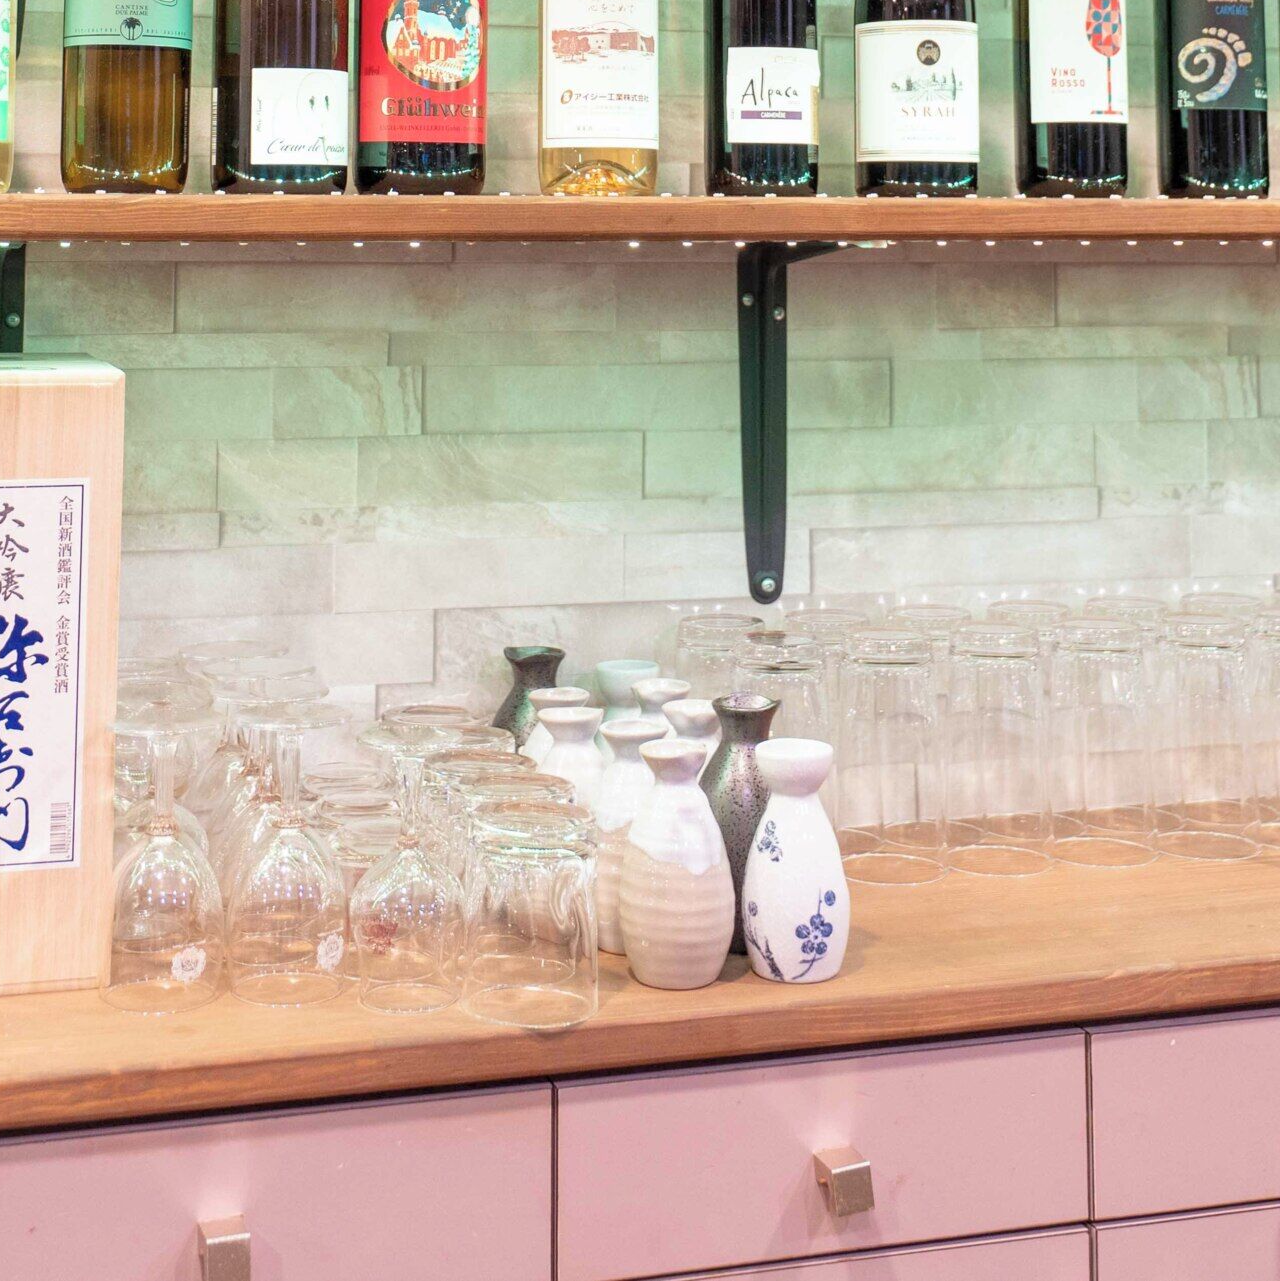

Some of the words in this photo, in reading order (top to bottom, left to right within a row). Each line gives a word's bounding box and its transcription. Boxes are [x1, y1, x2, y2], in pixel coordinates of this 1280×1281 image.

[740, 67, 799, 108] Alpaca
[1050, 78, 1086, 88] ROSSO
[900, 105, 957, 118] SYRAH
[57, 495, 74, 605] 全国新酒鑑評会
[53, 614, 70, 694] 金賞受賞酒
